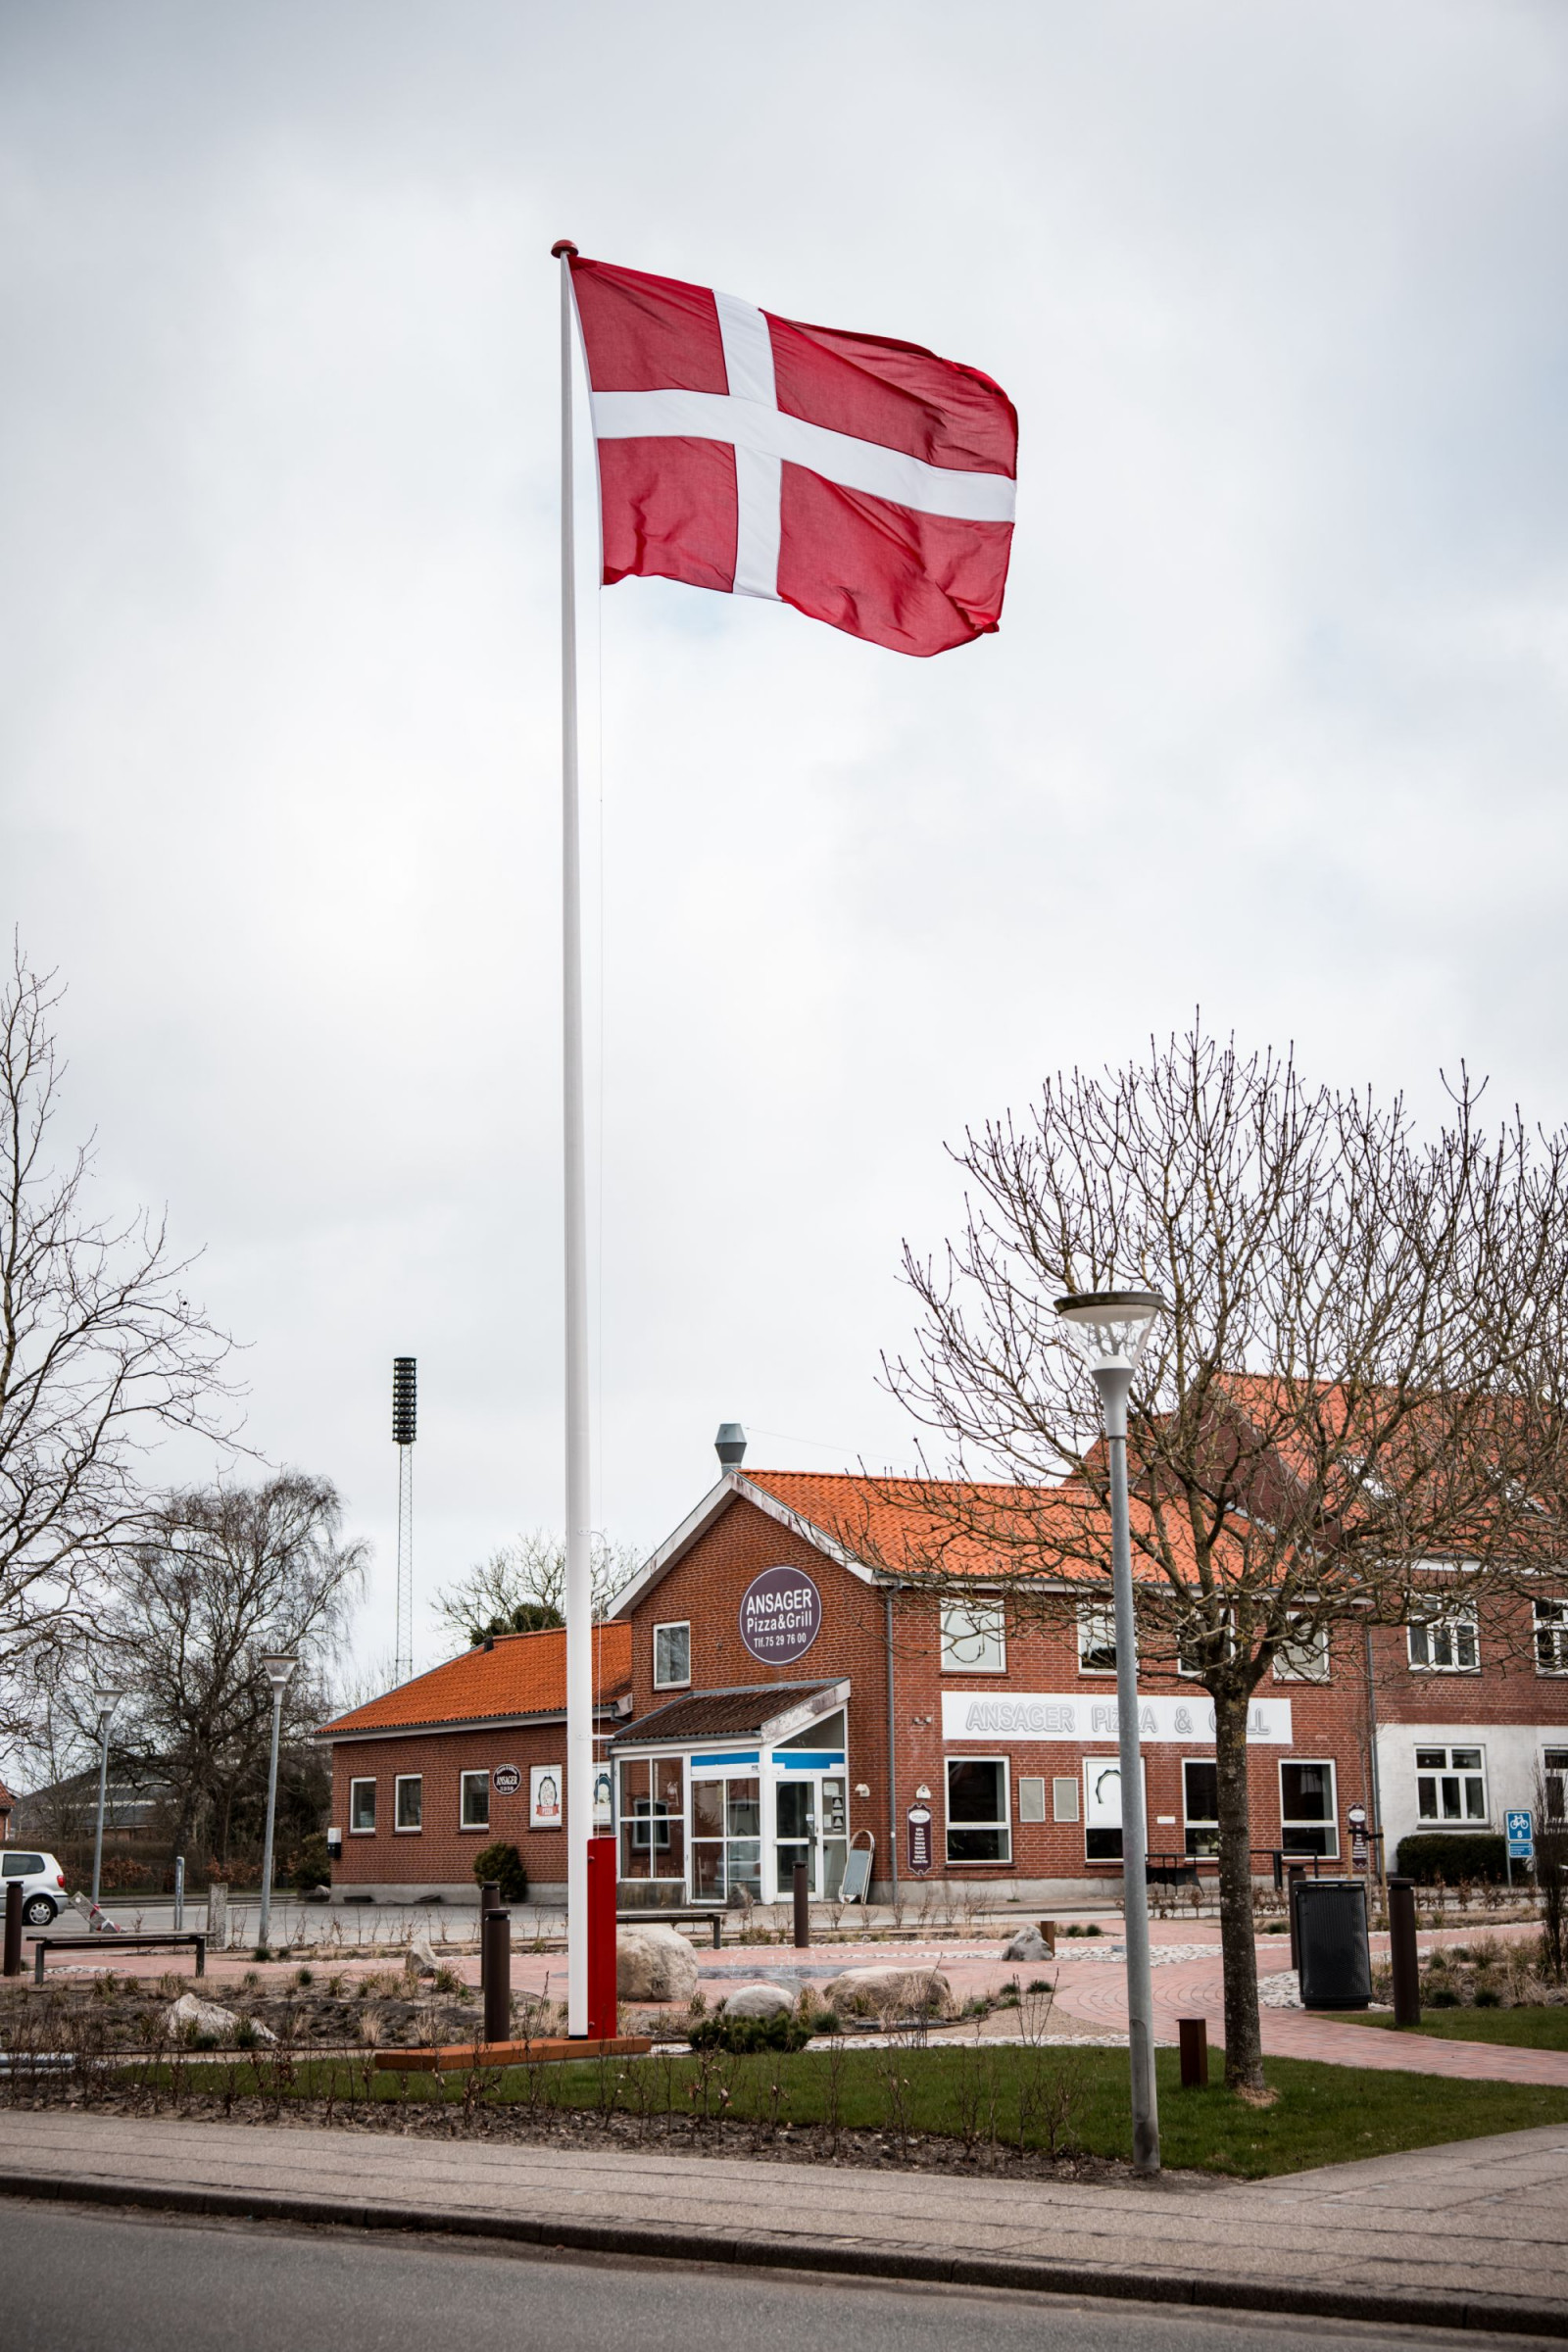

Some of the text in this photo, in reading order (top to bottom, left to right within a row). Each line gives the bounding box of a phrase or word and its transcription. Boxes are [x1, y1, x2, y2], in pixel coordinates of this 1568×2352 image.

[746, 1588, 812, 1615] ANSAGER
[747, 1610, 812, 1634] Pizza&Grill
[775, 1635, 785, 1646] 29
[786, 1633, 796, 1645] 76
[797, 1632, 807, 1643] 00
[966, 1701, 1076, 1733] ANSAGER
[1175, 1706, 1194, 1734] &
